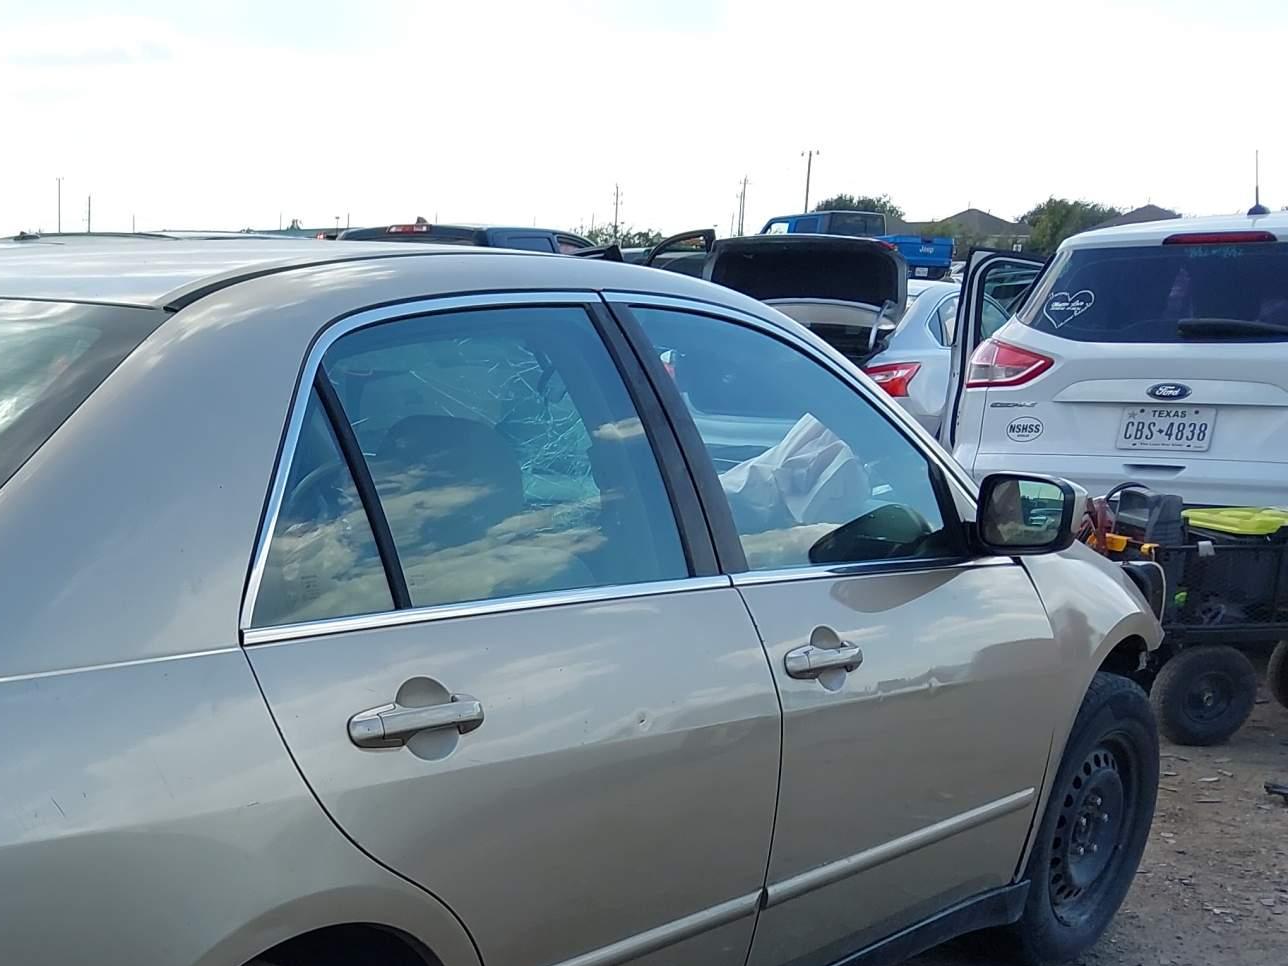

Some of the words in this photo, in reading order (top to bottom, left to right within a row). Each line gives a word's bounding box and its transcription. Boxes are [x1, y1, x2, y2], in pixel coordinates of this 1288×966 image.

[1152, 410, 1187, 418] TEXAS
[1008, 423, 1041, 433] NSHSS
[1124, 421, 1156, 440] CBS
[1164, 422, 1208, 441] 4838
